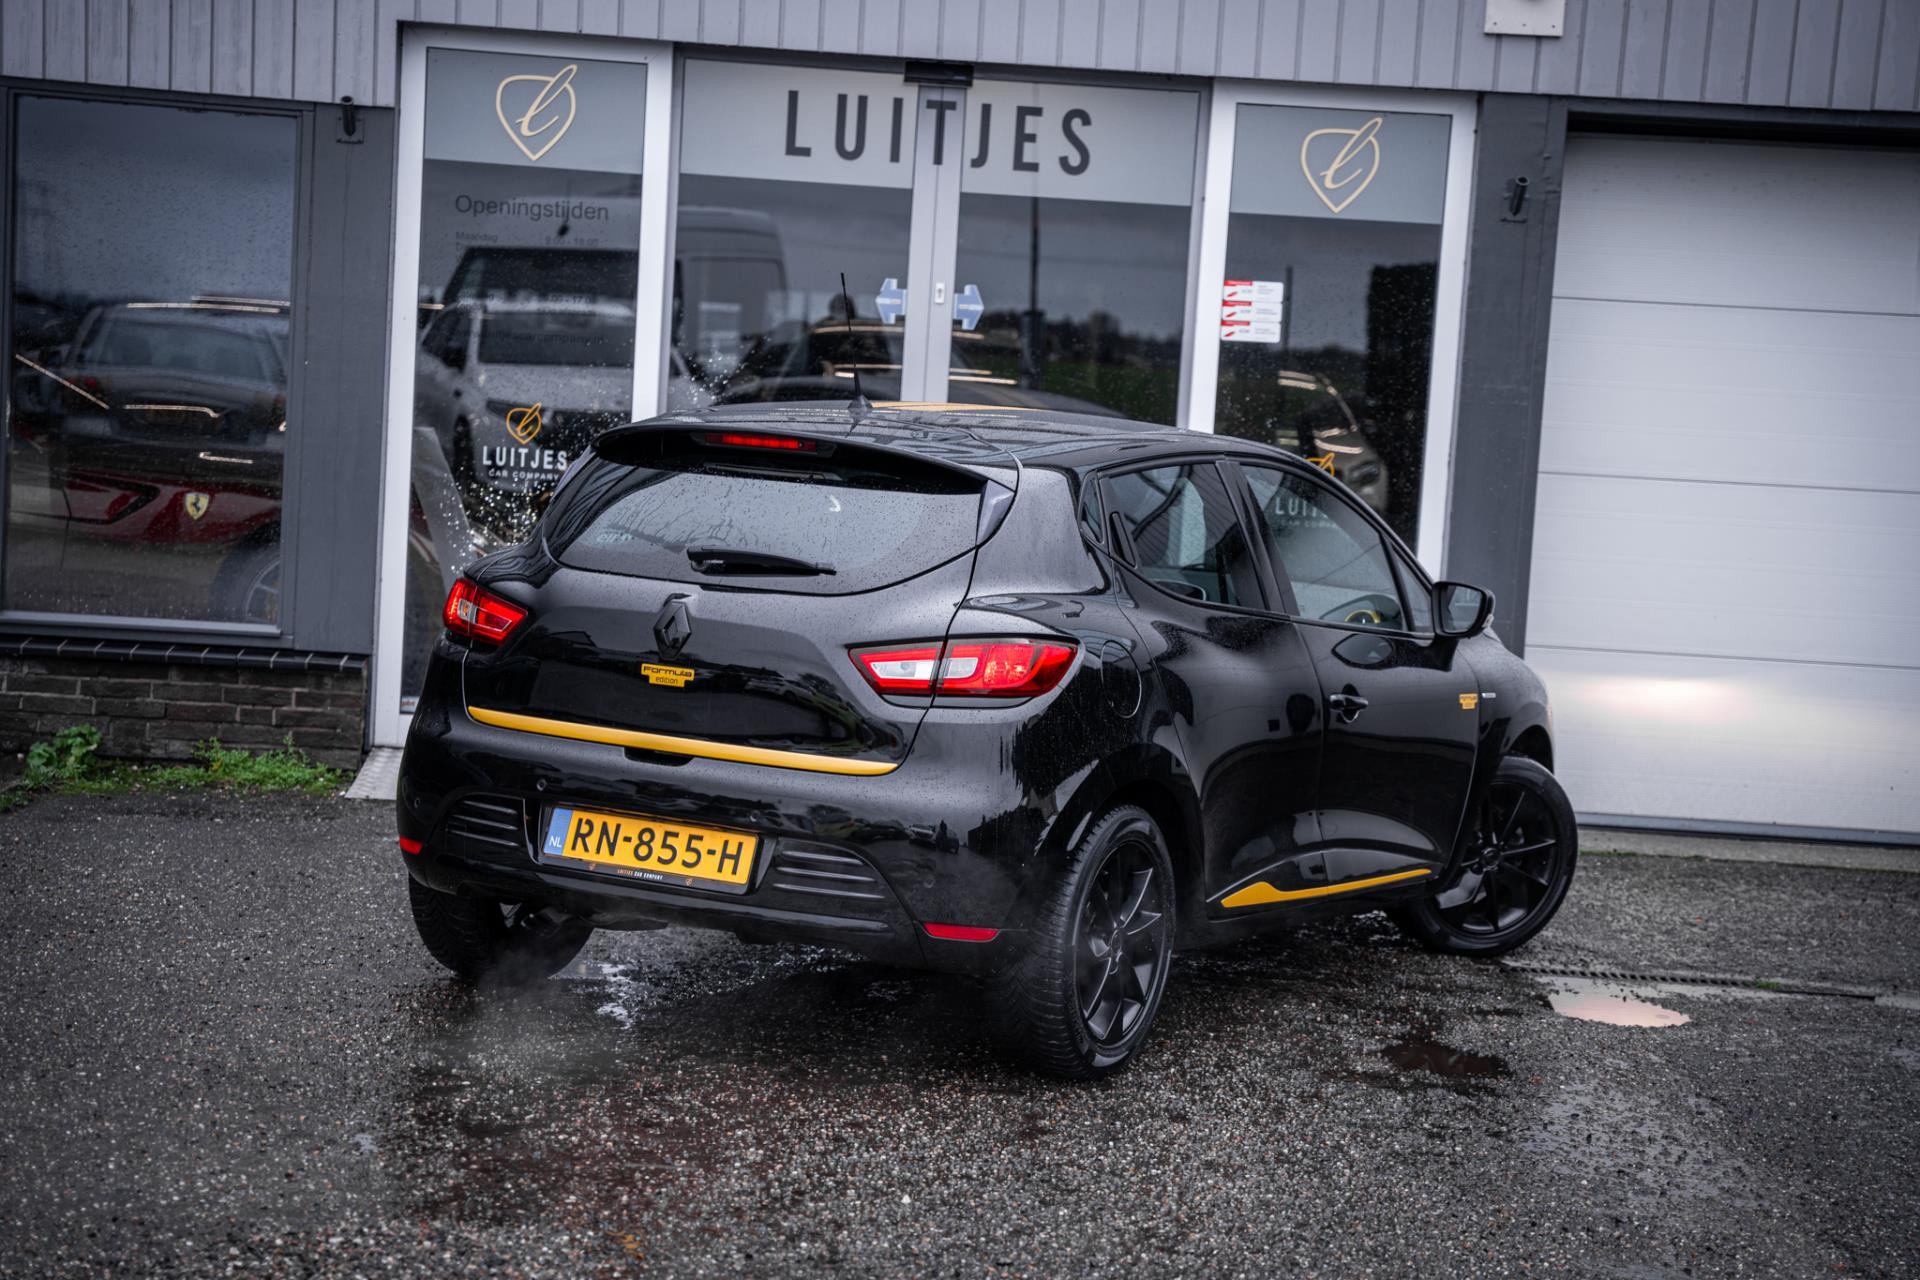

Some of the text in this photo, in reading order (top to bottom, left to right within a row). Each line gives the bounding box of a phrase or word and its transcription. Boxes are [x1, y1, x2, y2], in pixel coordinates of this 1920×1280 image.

[785, 89, 1092, 176] LUITJES
[455, 194, 609, 222] Openingstijden
[482, 445, 568, 471] LUITJES
[488, 469, 560, 481] CAR COMPANY
[549, 835, 562, 848] NL
[571, 817, 744, 876] RN-855-H
